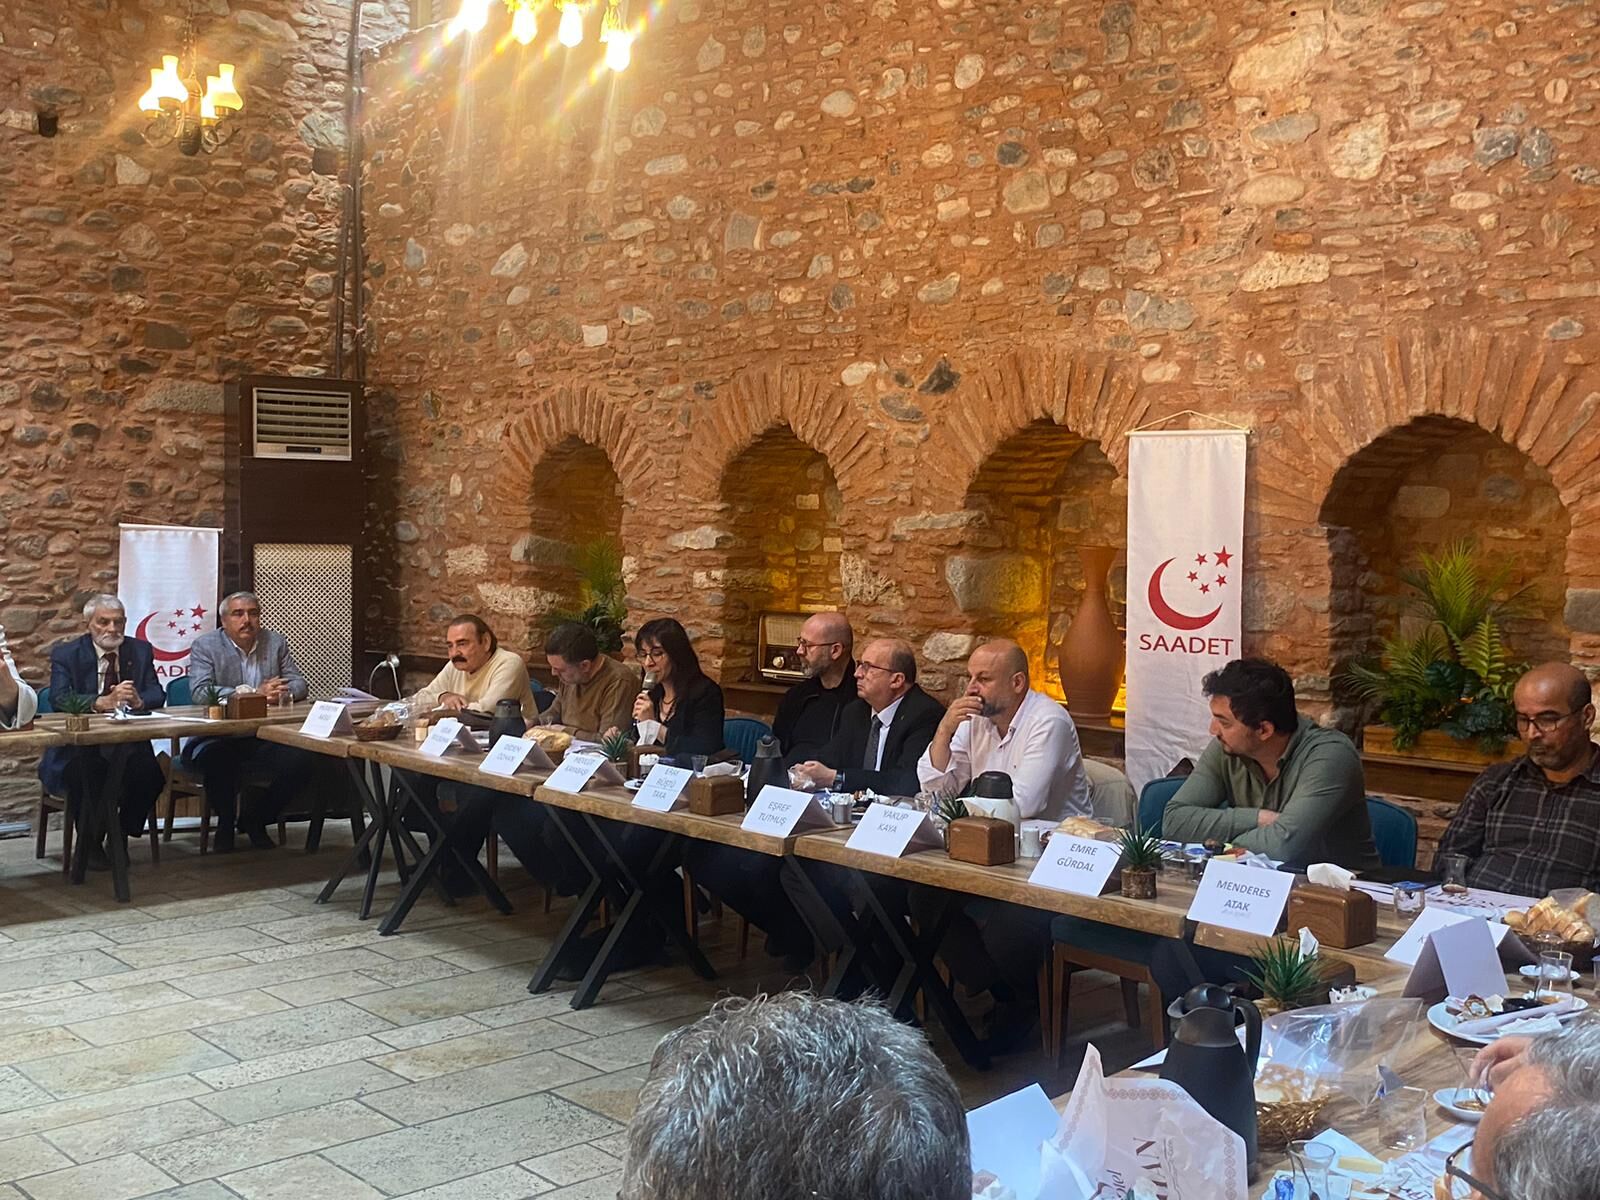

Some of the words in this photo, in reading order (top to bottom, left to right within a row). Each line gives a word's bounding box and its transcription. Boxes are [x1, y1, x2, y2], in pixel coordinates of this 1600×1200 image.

[1139, 633, 1234, 656] SAADET
[768, 801, 792, 812] EŞREF
[759, 813, 787, 825] TUTMUŞ
[883, 809, 909, 821] YAKUP
[877, 823, 897, 833] KAYA
[1070, 843, 1098, 856] EMRE
[1056, 856, 1095, 872] GÜRDAL
[1215, 880, 1272, 898] MENDERES
[1223, 899, 1250, 912] ATAK
